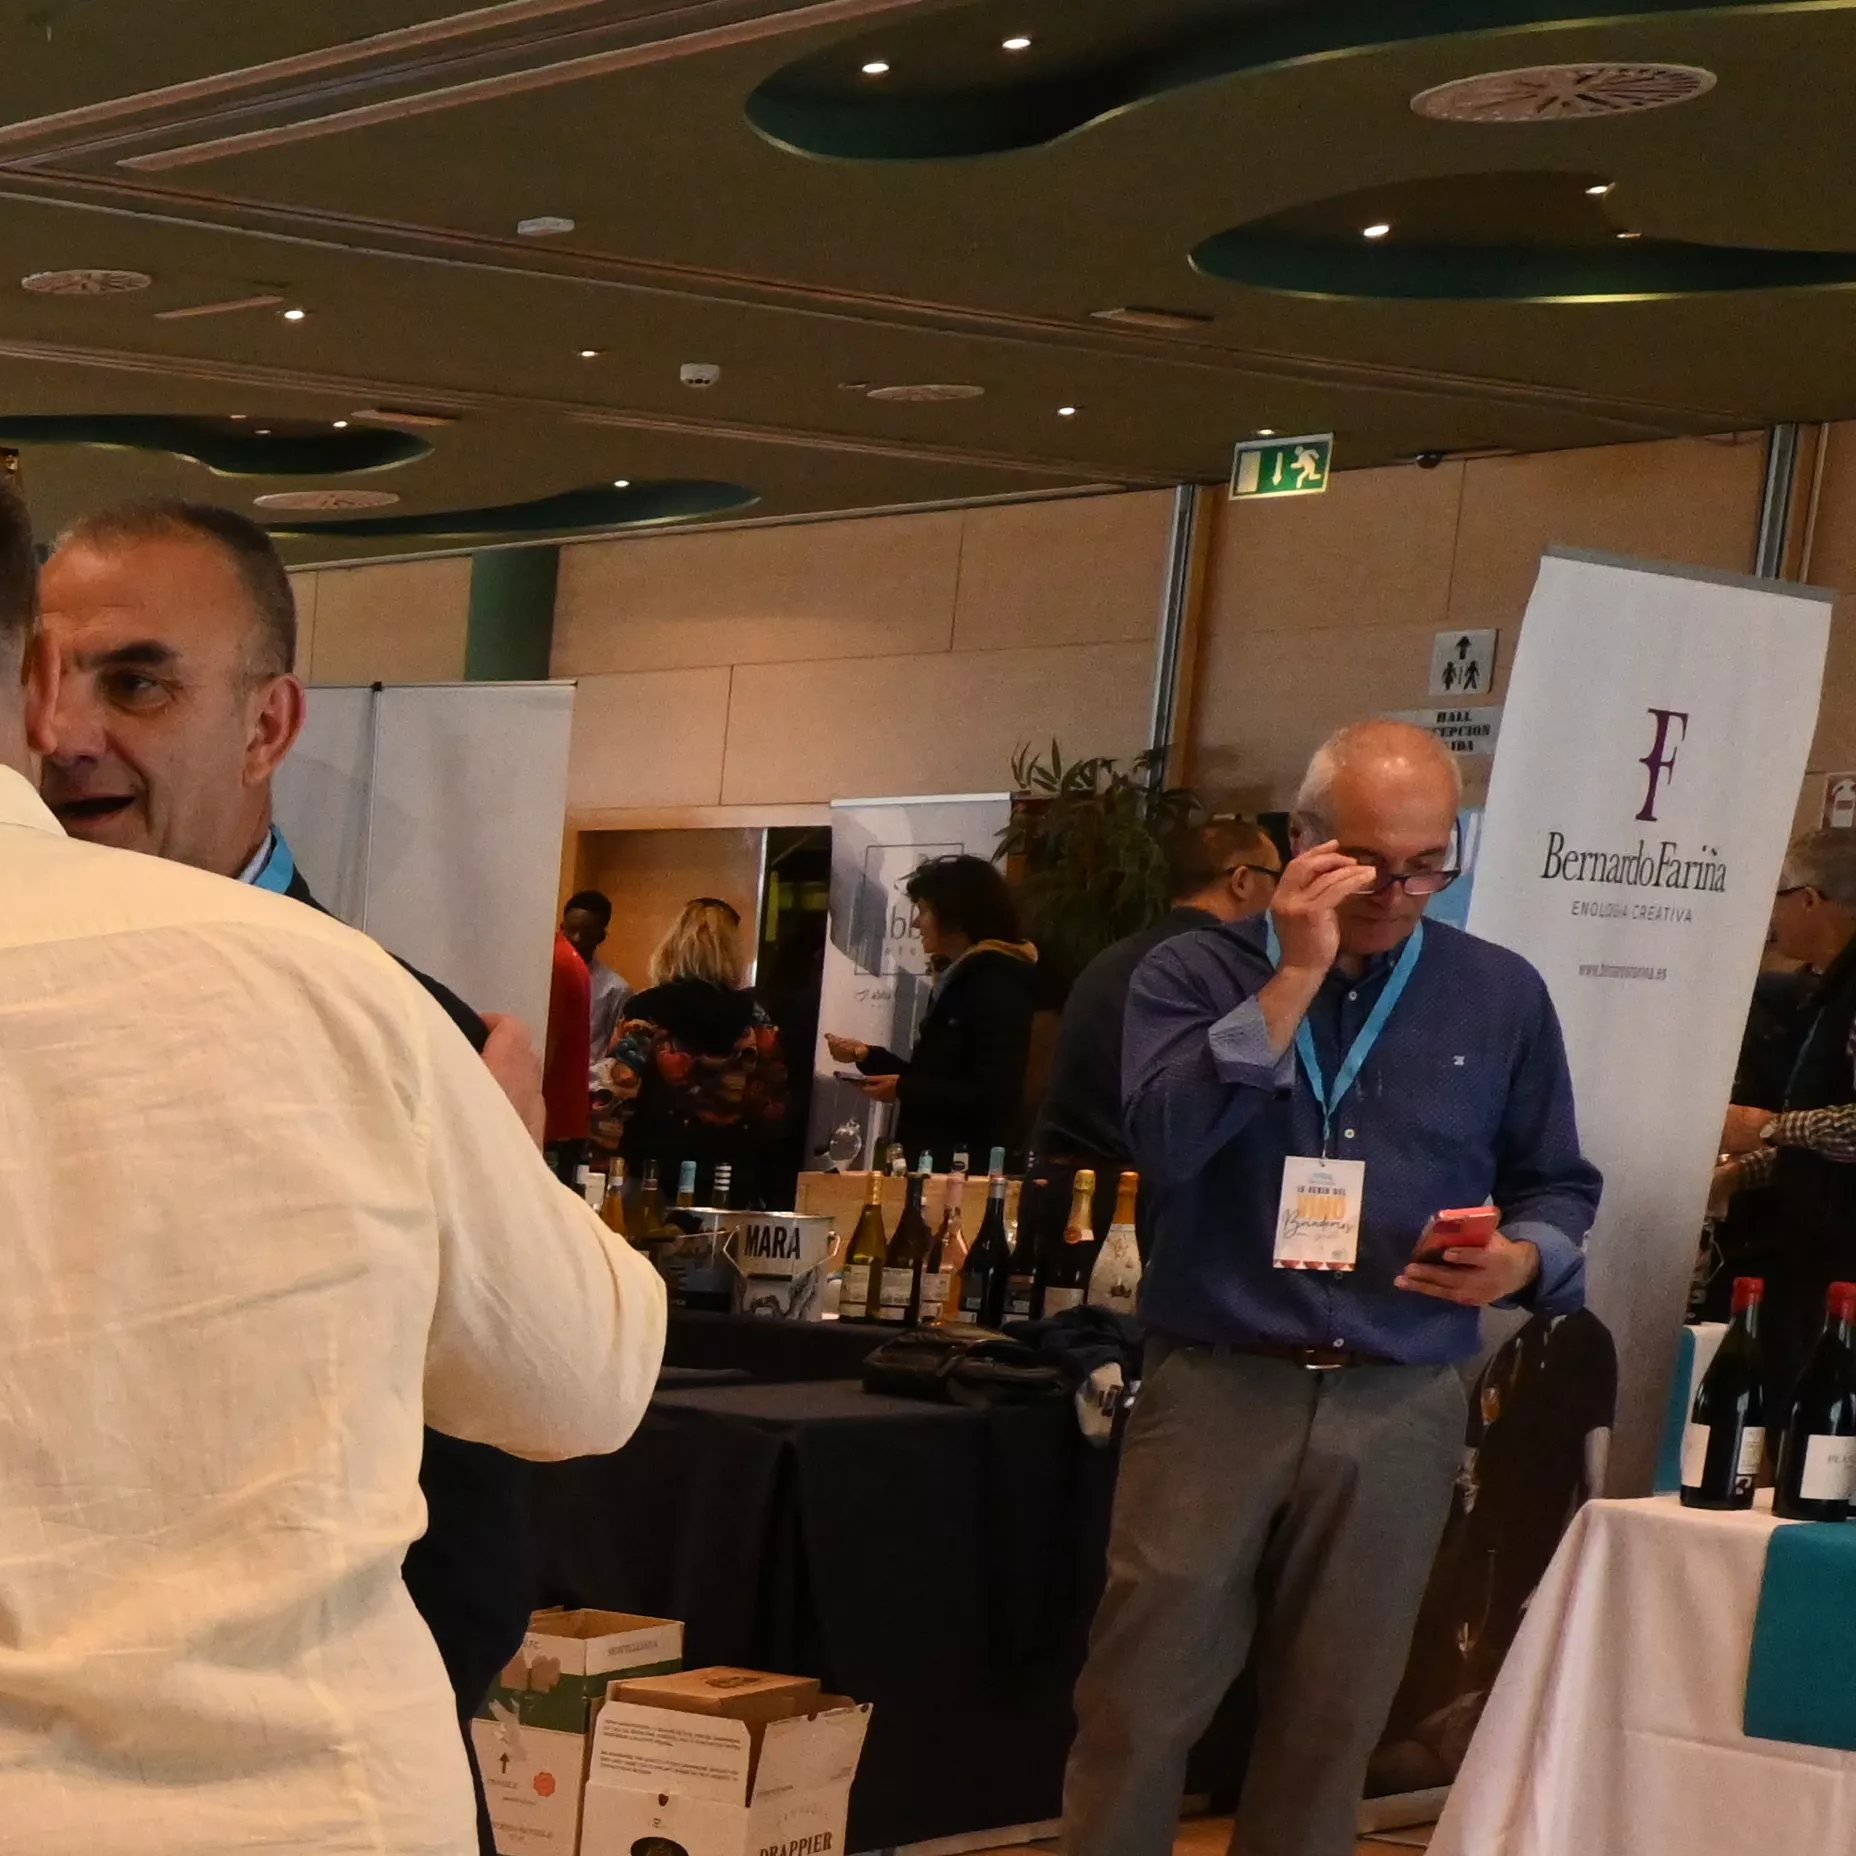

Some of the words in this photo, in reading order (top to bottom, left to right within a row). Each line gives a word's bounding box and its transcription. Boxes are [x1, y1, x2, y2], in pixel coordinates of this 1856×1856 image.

[1436, 711, 1472, 723] HALL
[1433, 724, 1491, 737] CEPCION
[1635, 708, 1689, 822] F
[1632, 904, 1693, 924] CREATIVA
[744, 1225, 801, 1259] MARA
